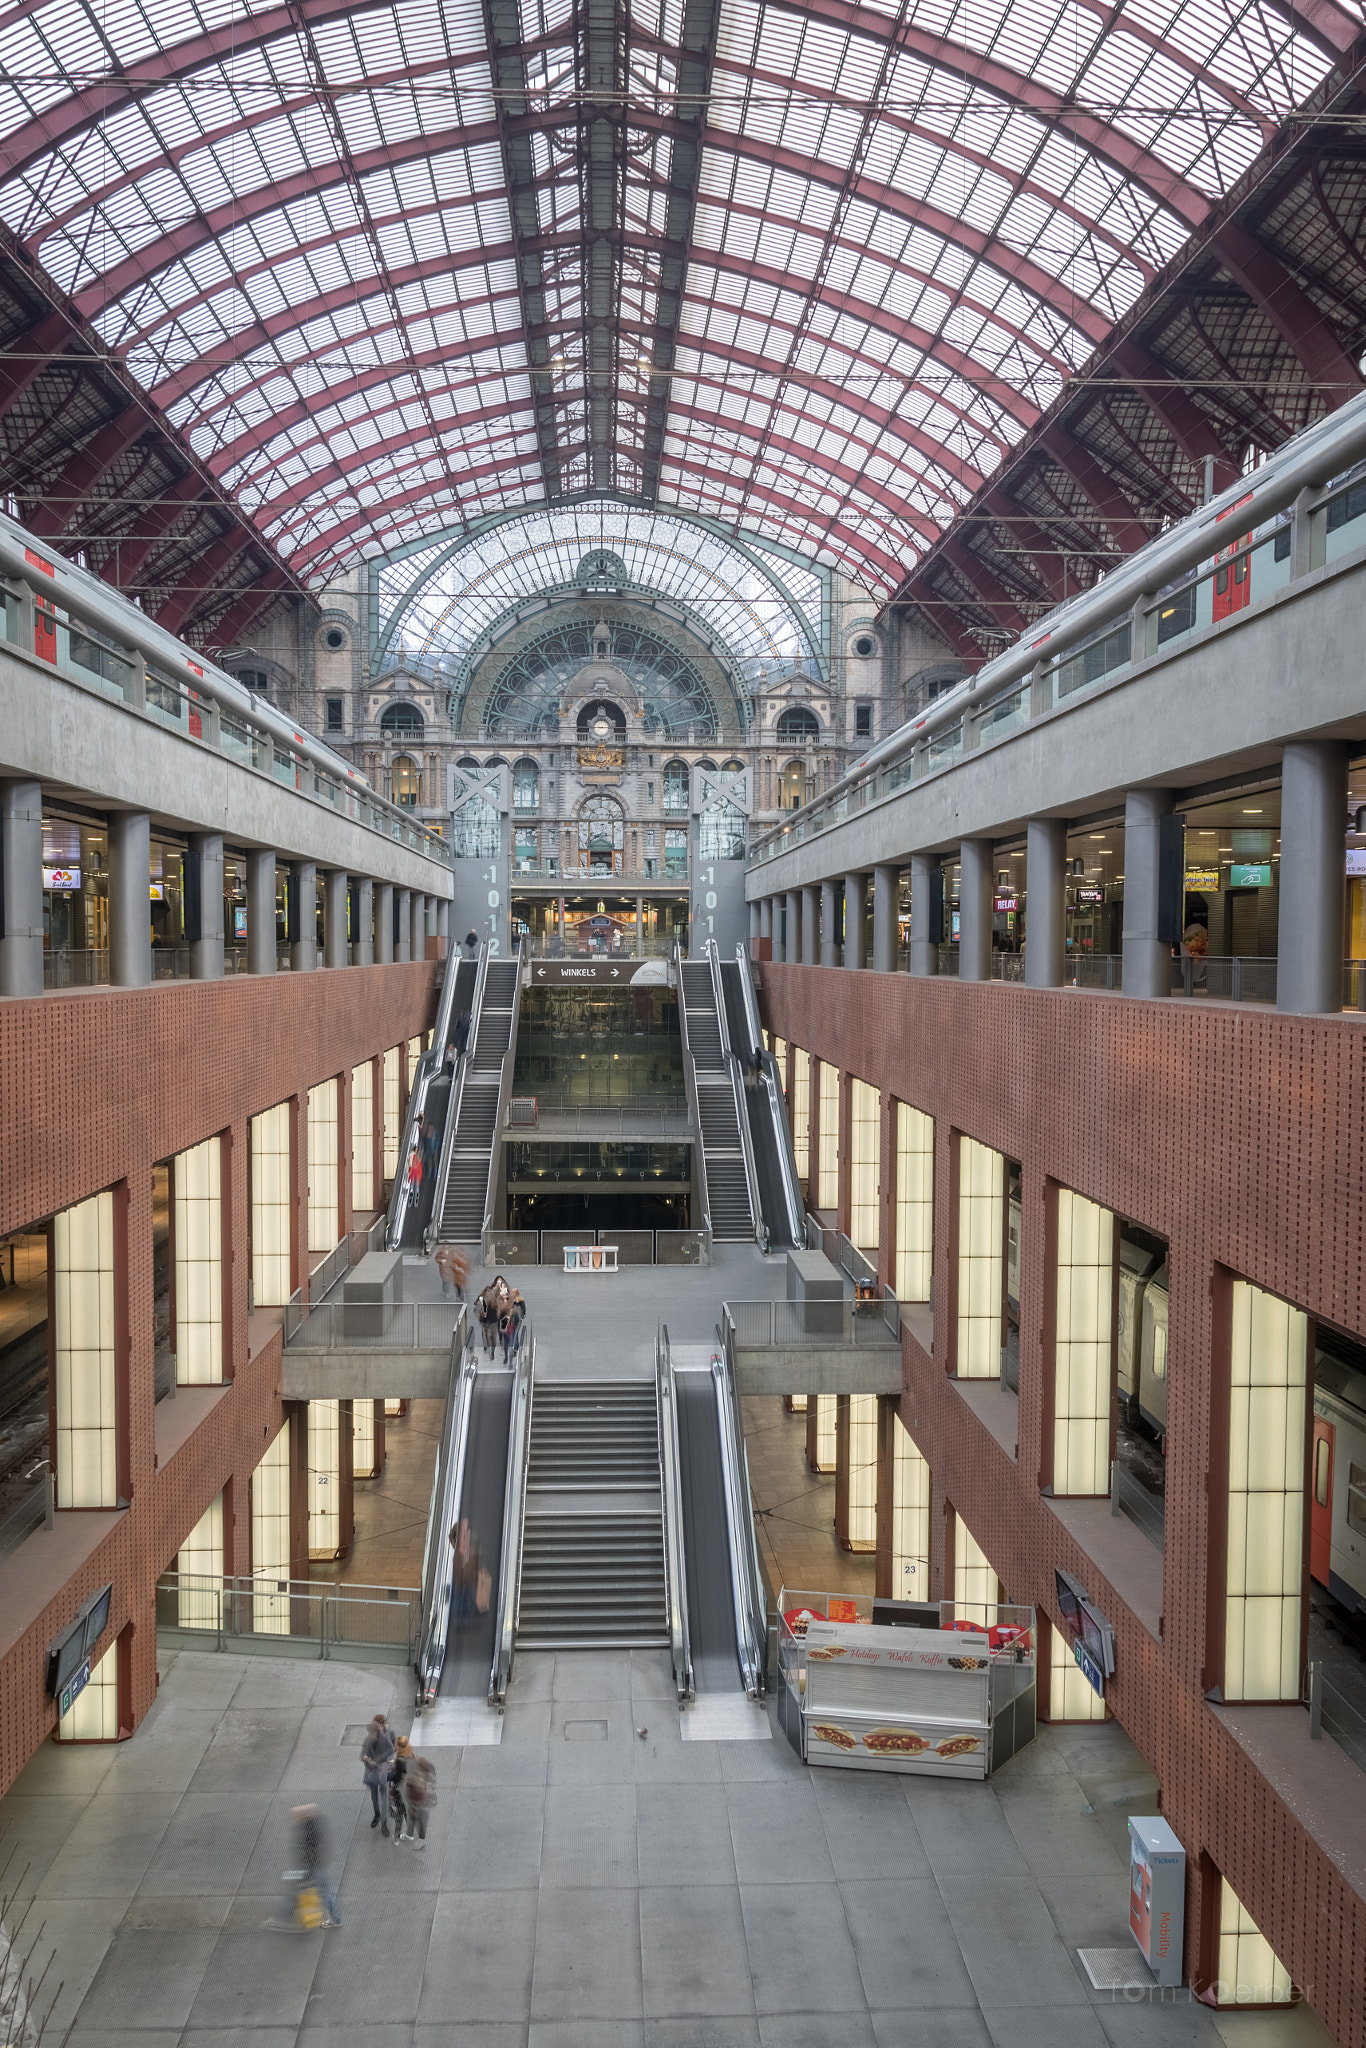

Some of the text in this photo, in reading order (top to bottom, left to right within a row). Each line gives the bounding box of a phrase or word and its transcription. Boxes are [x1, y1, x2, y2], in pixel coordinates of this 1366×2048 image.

[482, 865, 497, 884] +1
[700, 866, 714, 885] +1
[488, 889, 500, 908] 0
[705, 890, 717, 909] 0
[997, 899, 1016, 910] RELAY
[483, 913, 497, 933] -1
[701, 915, 714, 934] -1
[560, 968, 597, 977] WINKELS
[318, 1477, 328, 1485] 22
[904, 1565, 916, 1574] 23
[850, 1648, 944, 1667] Hotdogs Wafels Koffie
[1156, 1912, 1171, 1958] Mobility
